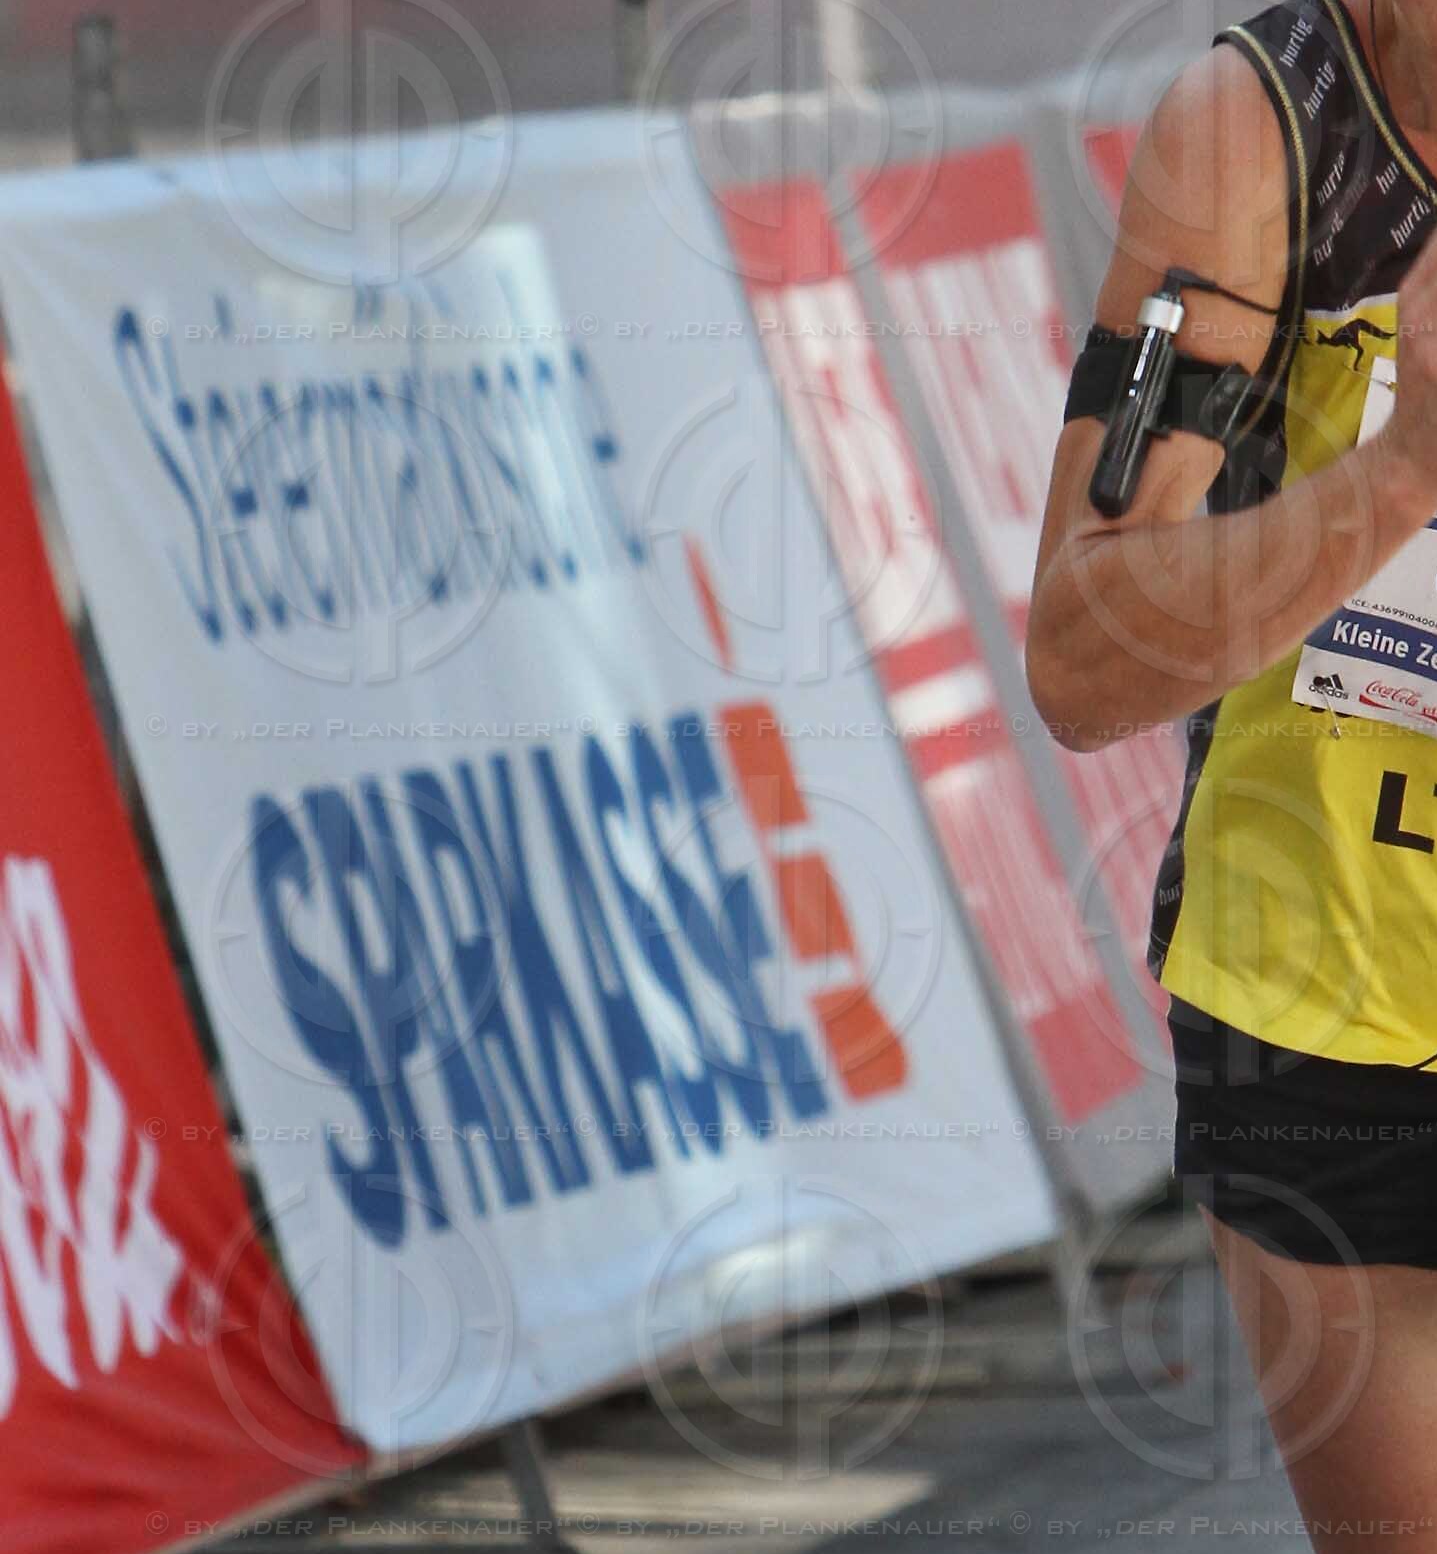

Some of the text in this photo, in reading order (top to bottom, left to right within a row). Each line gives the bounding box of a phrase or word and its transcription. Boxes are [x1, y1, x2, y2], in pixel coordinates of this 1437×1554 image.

[1279, 17, 1313, 68] hurtig
[1303, 60, 1337, 121] hurtig
[1332, 619, 1410, 658] Kleine
[249, 709, 829, 1252] SPARKASSE
